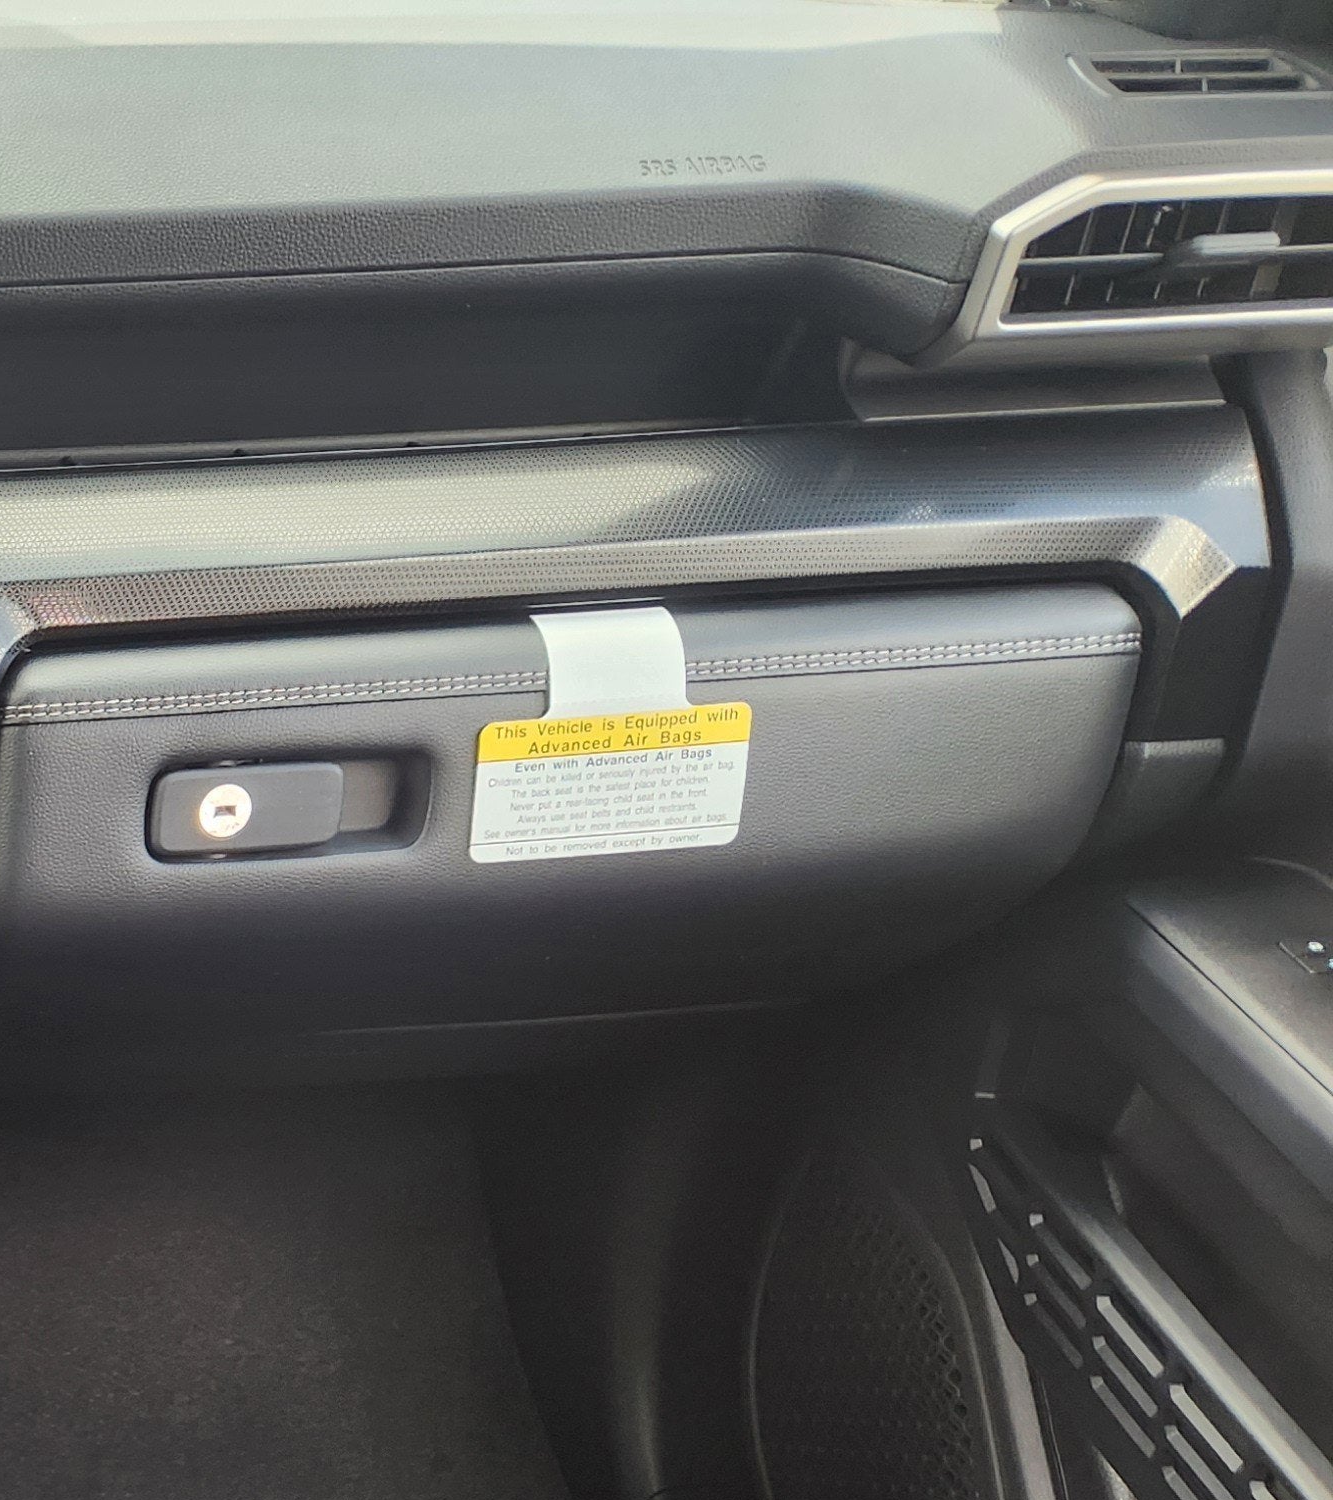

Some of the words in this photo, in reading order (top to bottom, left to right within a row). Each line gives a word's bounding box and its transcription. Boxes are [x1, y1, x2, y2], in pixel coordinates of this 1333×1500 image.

[638, 158, 677, 176] SRS
[685, 155, 766, 176] AIRBAG
[495, 726, 527, 740] This
[537, 721, 592, 737] Vehicle
[603, 719, 615, 731] is
[625, 713, 698, 732] Equipped
[707, 709, 739, 723] with
[528, 736, 612, 755] Advanced
[623, 733, 648, 747] Air
[660, 729, 702, 745] Bags
[515, 761, 546, 773] Even
[553, 757, 580, 770] with
[586, 752, 648, 767] Advanced
[655, 750, 673, 762] Air
[681, 747, 712, 761] Bags
[506, 846, 523, 855] Not
[530, 845, 538, 853] to
[545, 844, 557, 852] be
[563, 840, 607, 851] removed
[612, 837, 645, 848] except
[651, 835, 663, 846] by
[669, 833, 703, 843] owner.
